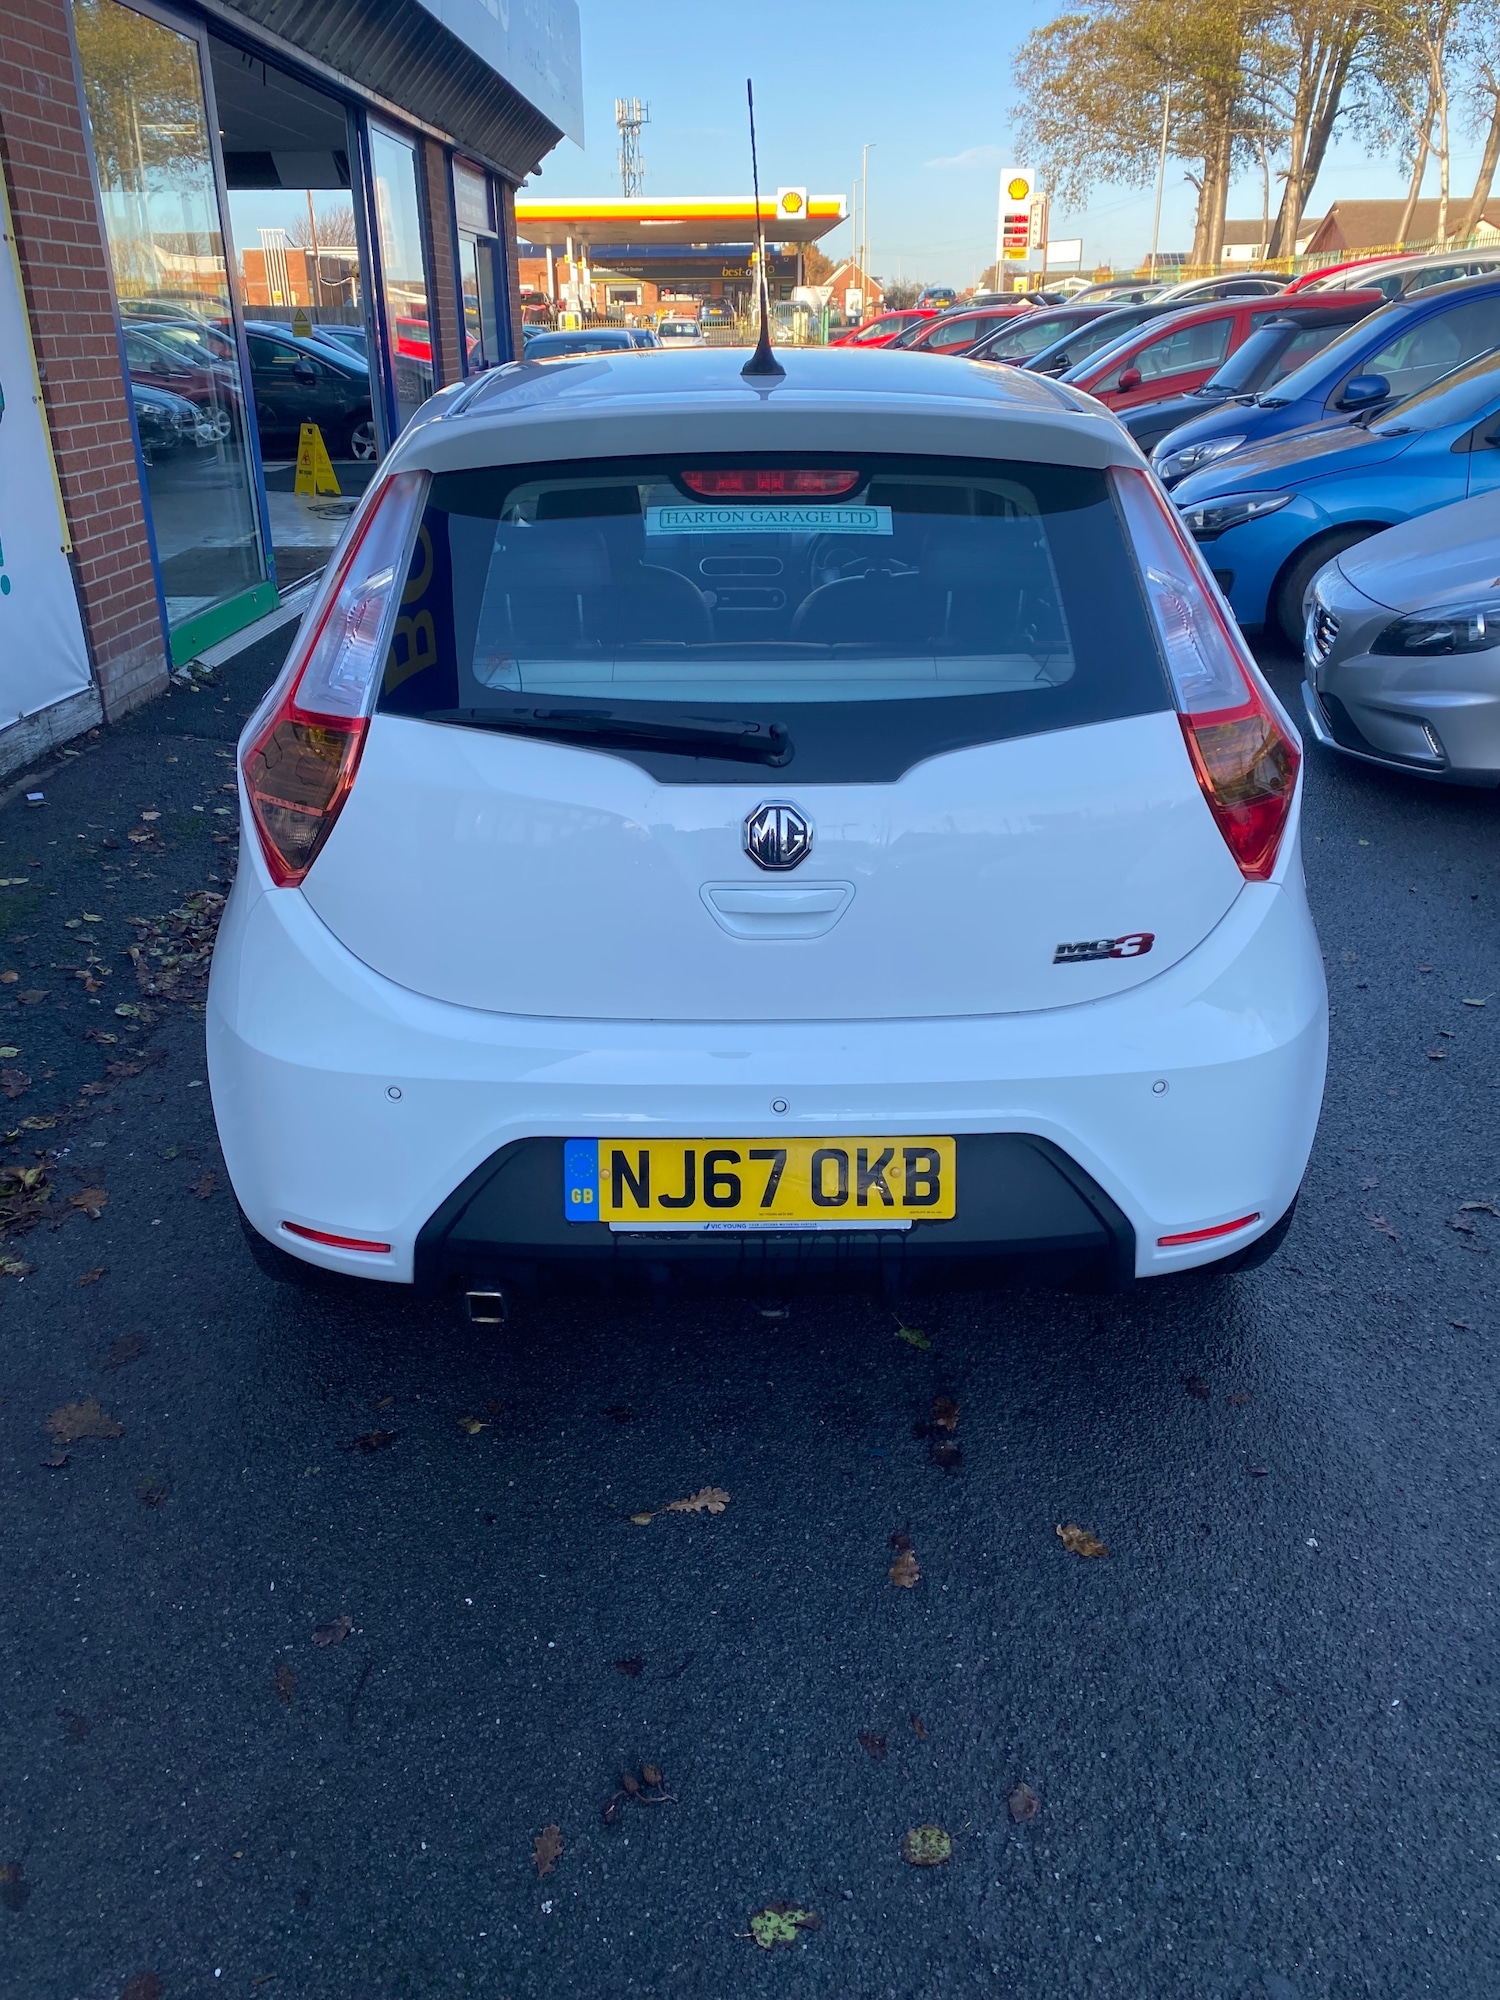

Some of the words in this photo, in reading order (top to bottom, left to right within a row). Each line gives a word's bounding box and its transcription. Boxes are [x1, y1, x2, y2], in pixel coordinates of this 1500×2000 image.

[722, 266, 752, 277] best-o
[666, 511, 749, 524] HARTON
[750, 510, 831, 523] GARAGE
[837, 511, 872, 524] LTD
[750, 805, 806, 863] MG
[611, 1149, 787, 1208] NJ67
[811, 1147, 941, 1207] OKB
[571, 1188, 594, 1204] GB
